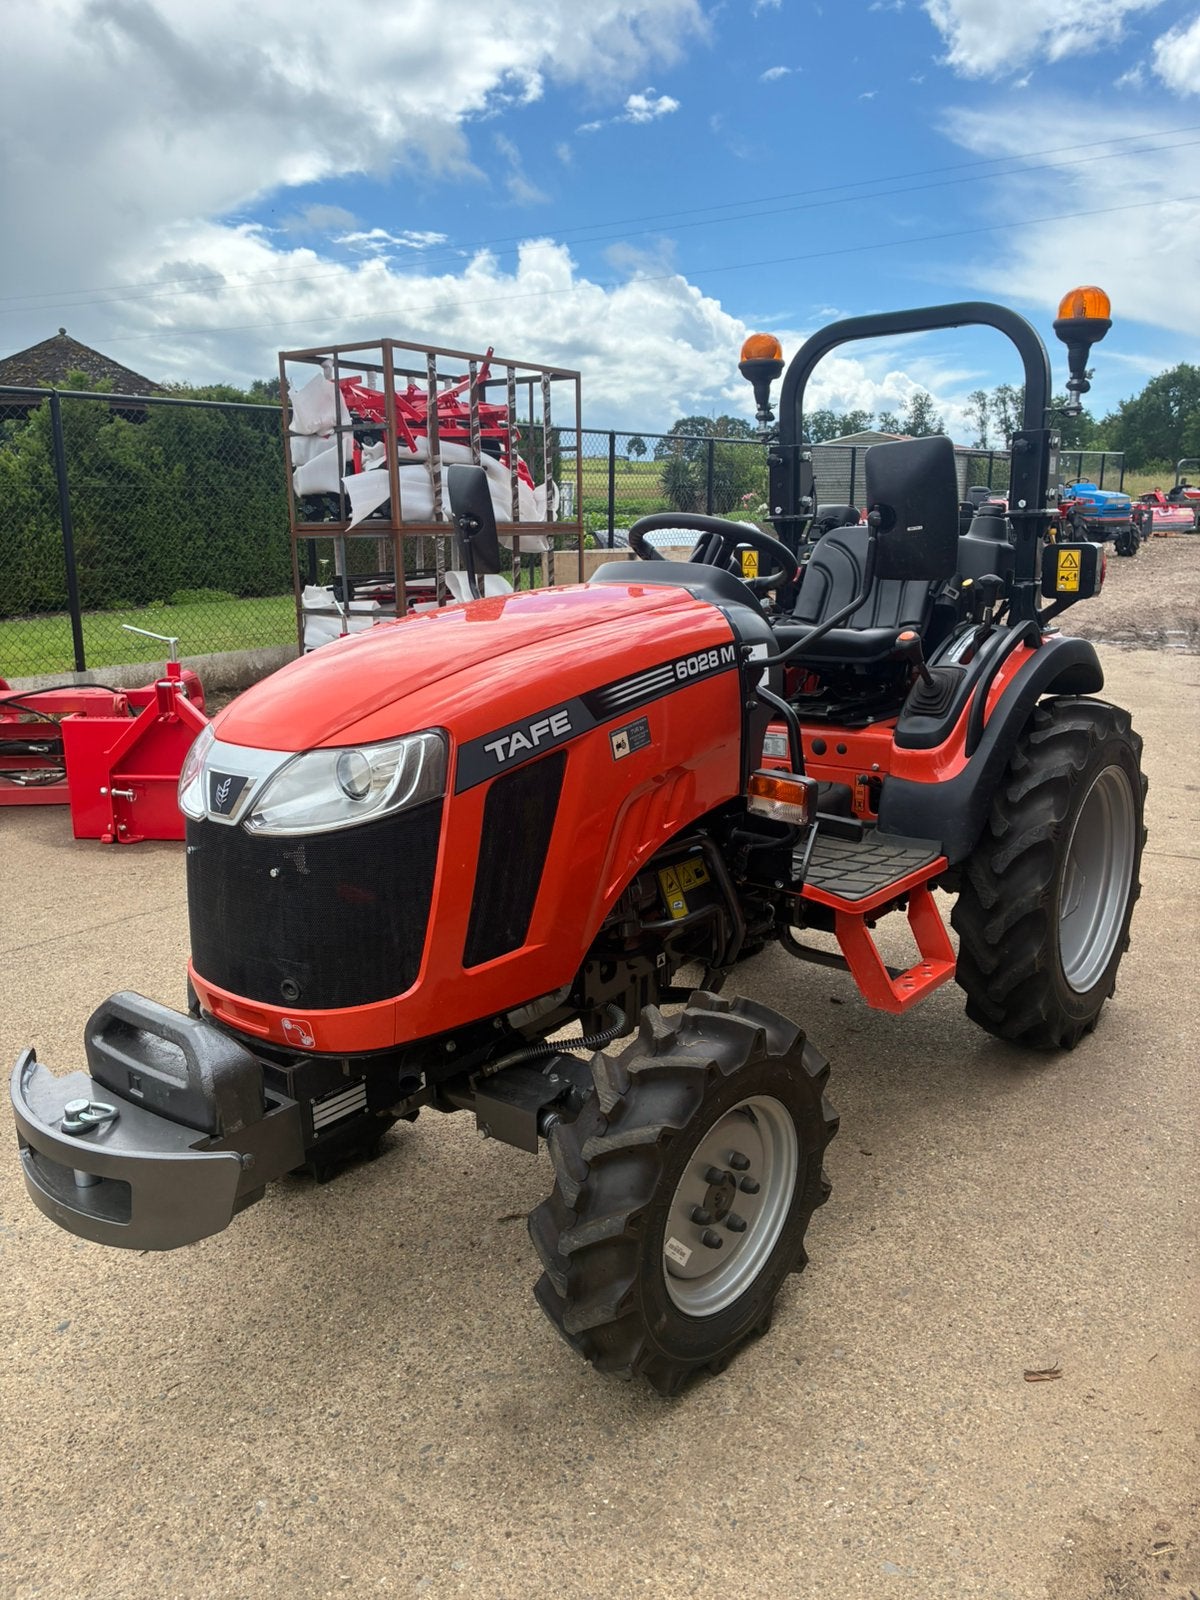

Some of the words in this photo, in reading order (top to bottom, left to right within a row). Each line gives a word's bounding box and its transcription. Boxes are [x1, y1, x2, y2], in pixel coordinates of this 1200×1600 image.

[484, 710, 572, 762] TAFE
[676, 650, 719, 679] 6028
[720, 645, 735, 664] M
